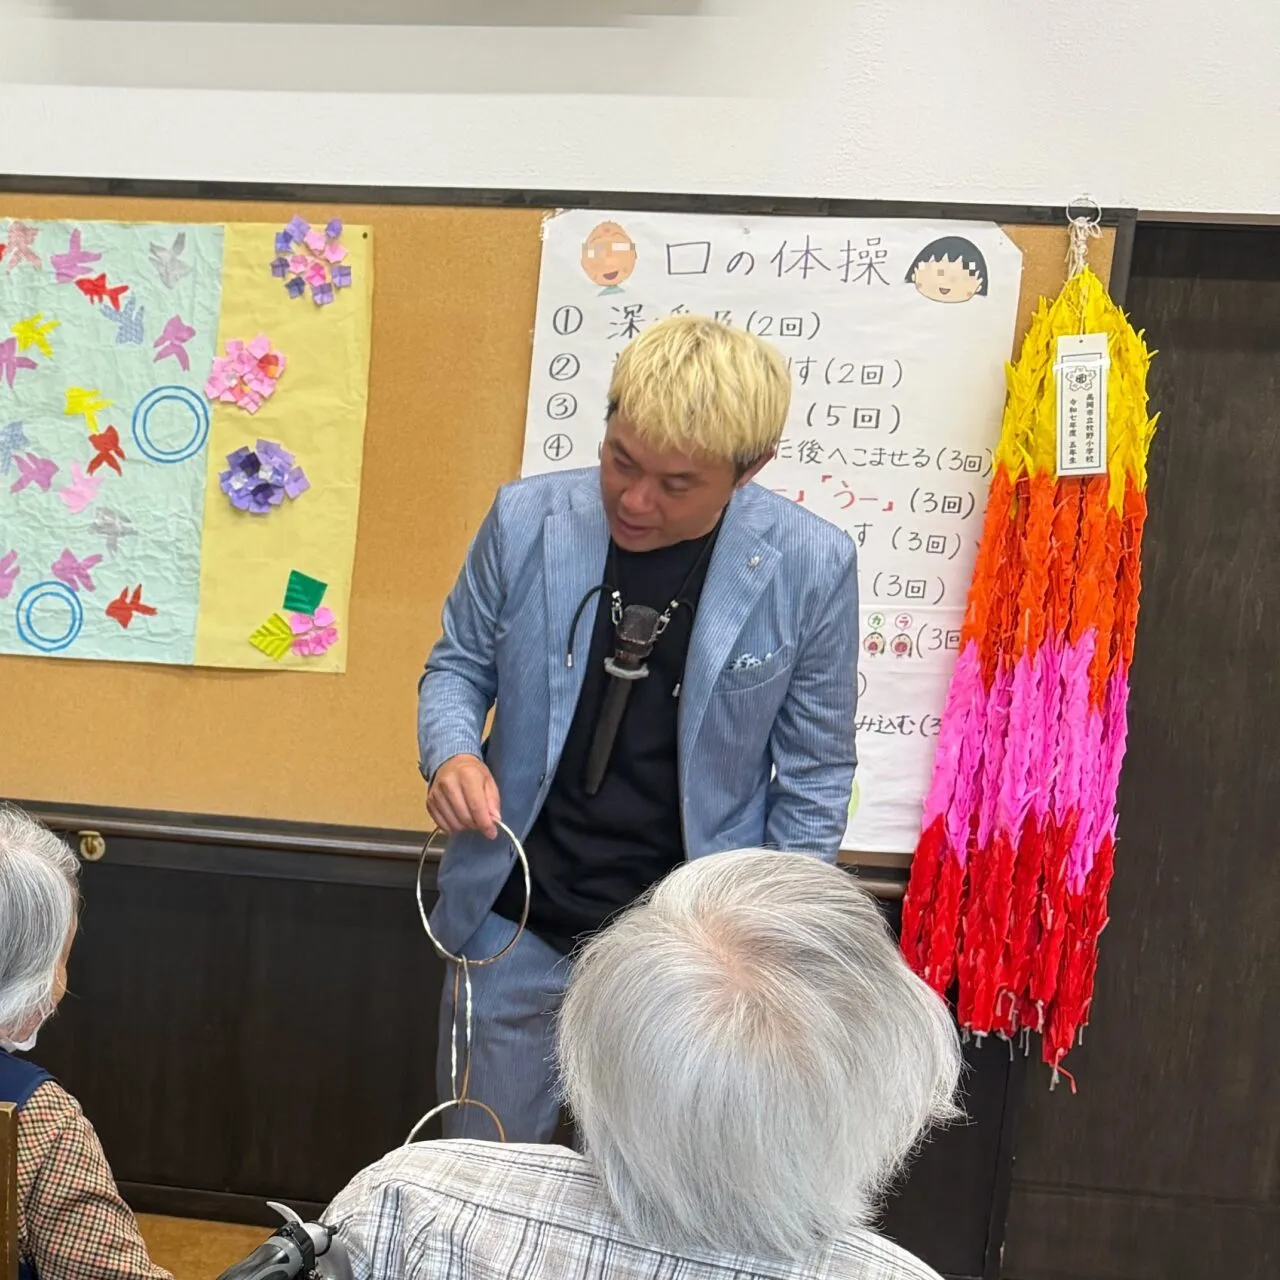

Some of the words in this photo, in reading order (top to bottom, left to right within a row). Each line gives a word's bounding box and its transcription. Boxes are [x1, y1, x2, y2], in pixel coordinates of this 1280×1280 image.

[665, 234, 891, 286] 口の体操
[806, 402, 901, 435] (5回)
[873, 571, 946, 606] (3回)
